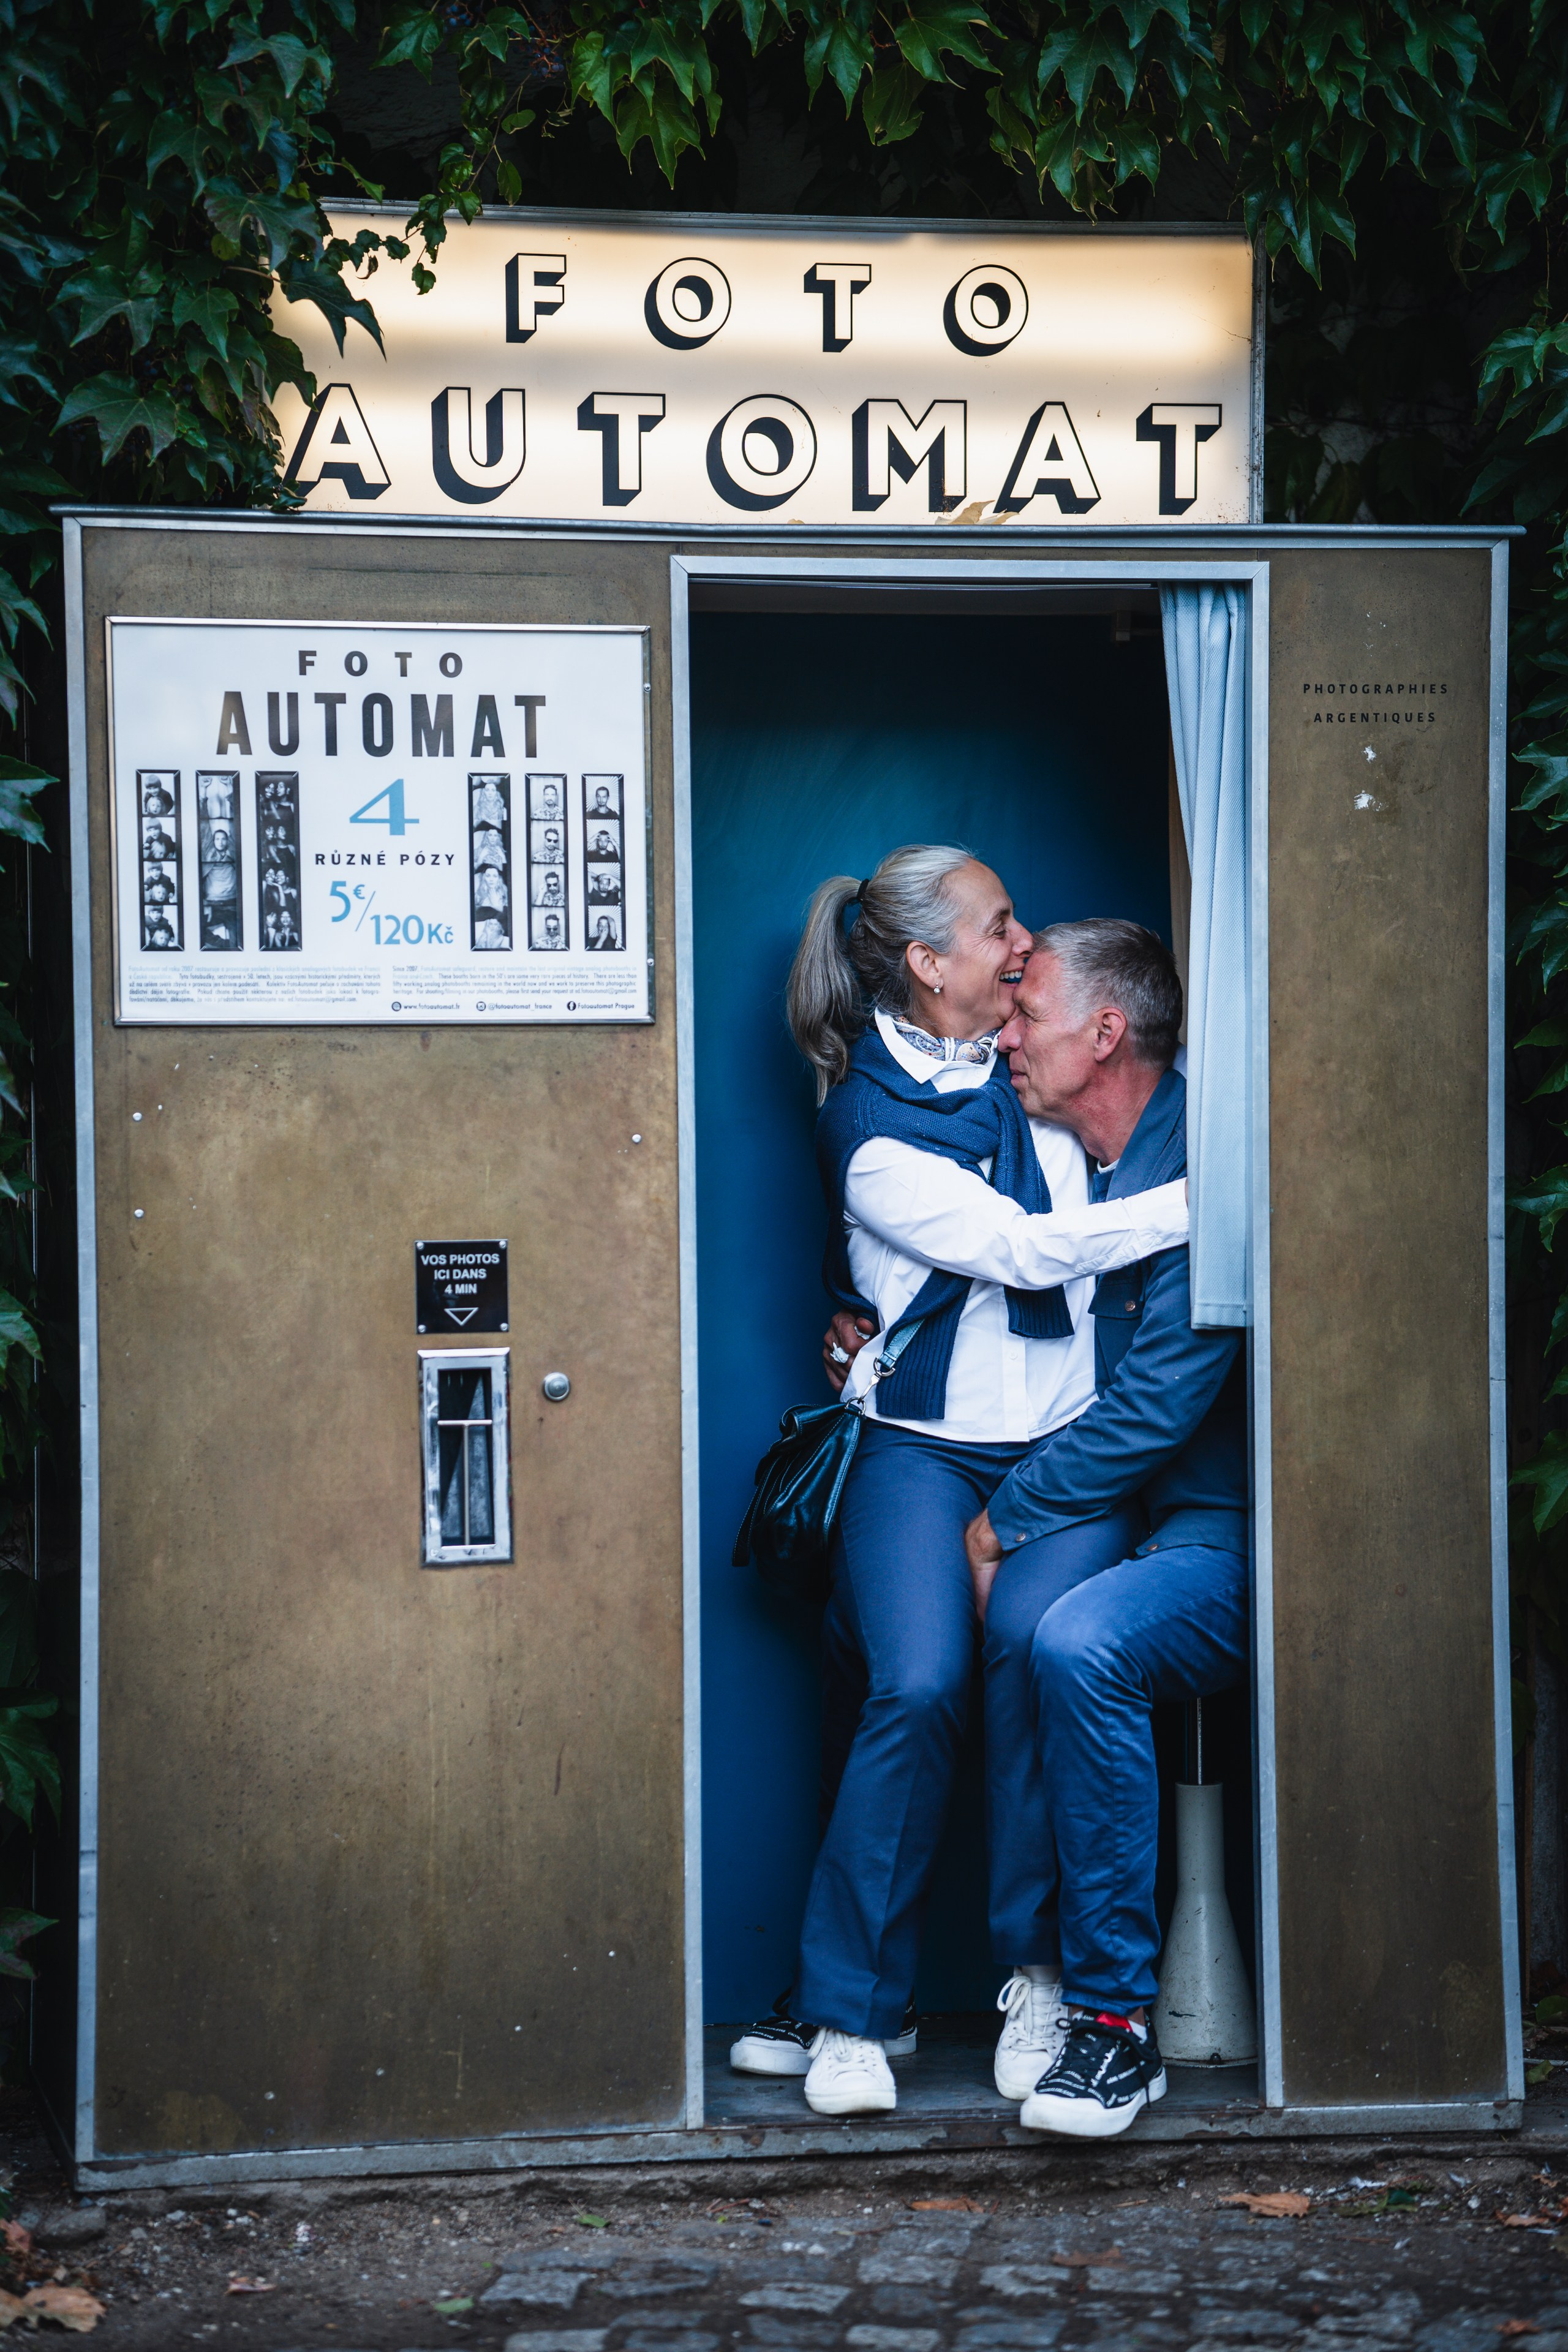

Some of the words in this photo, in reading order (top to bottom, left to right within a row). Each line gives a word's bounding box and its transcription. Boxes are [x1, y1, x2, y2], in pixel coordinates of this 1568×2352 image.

[505, 252, 1030, 357] FOTO
[284, 383, 1224, 515] AUTOMAT
[298, 650, 463, 678] FOTO
[1303, 684, 1449, 695] PHOTOGRAPHIES
[217, 691, 546, 758] AUTOMAT
[1314, 712, 1436, 723] ARGENTIQUES
[349, 778, 420, 835] 4
[315, 850, 386, 865] RŮZNÉ
[400, 850, 455, 865] PÓZY
[421, 1254, 447, 1265] VOS
[450, 1253, 500, 1265] PHOTOS
[434, 1269, 451, 1280] ICI
[453, 1268, 487, 1280] DANS
[445, 1283, 453, 1294] 4
[455, 1283, 477, 1294] MIN
